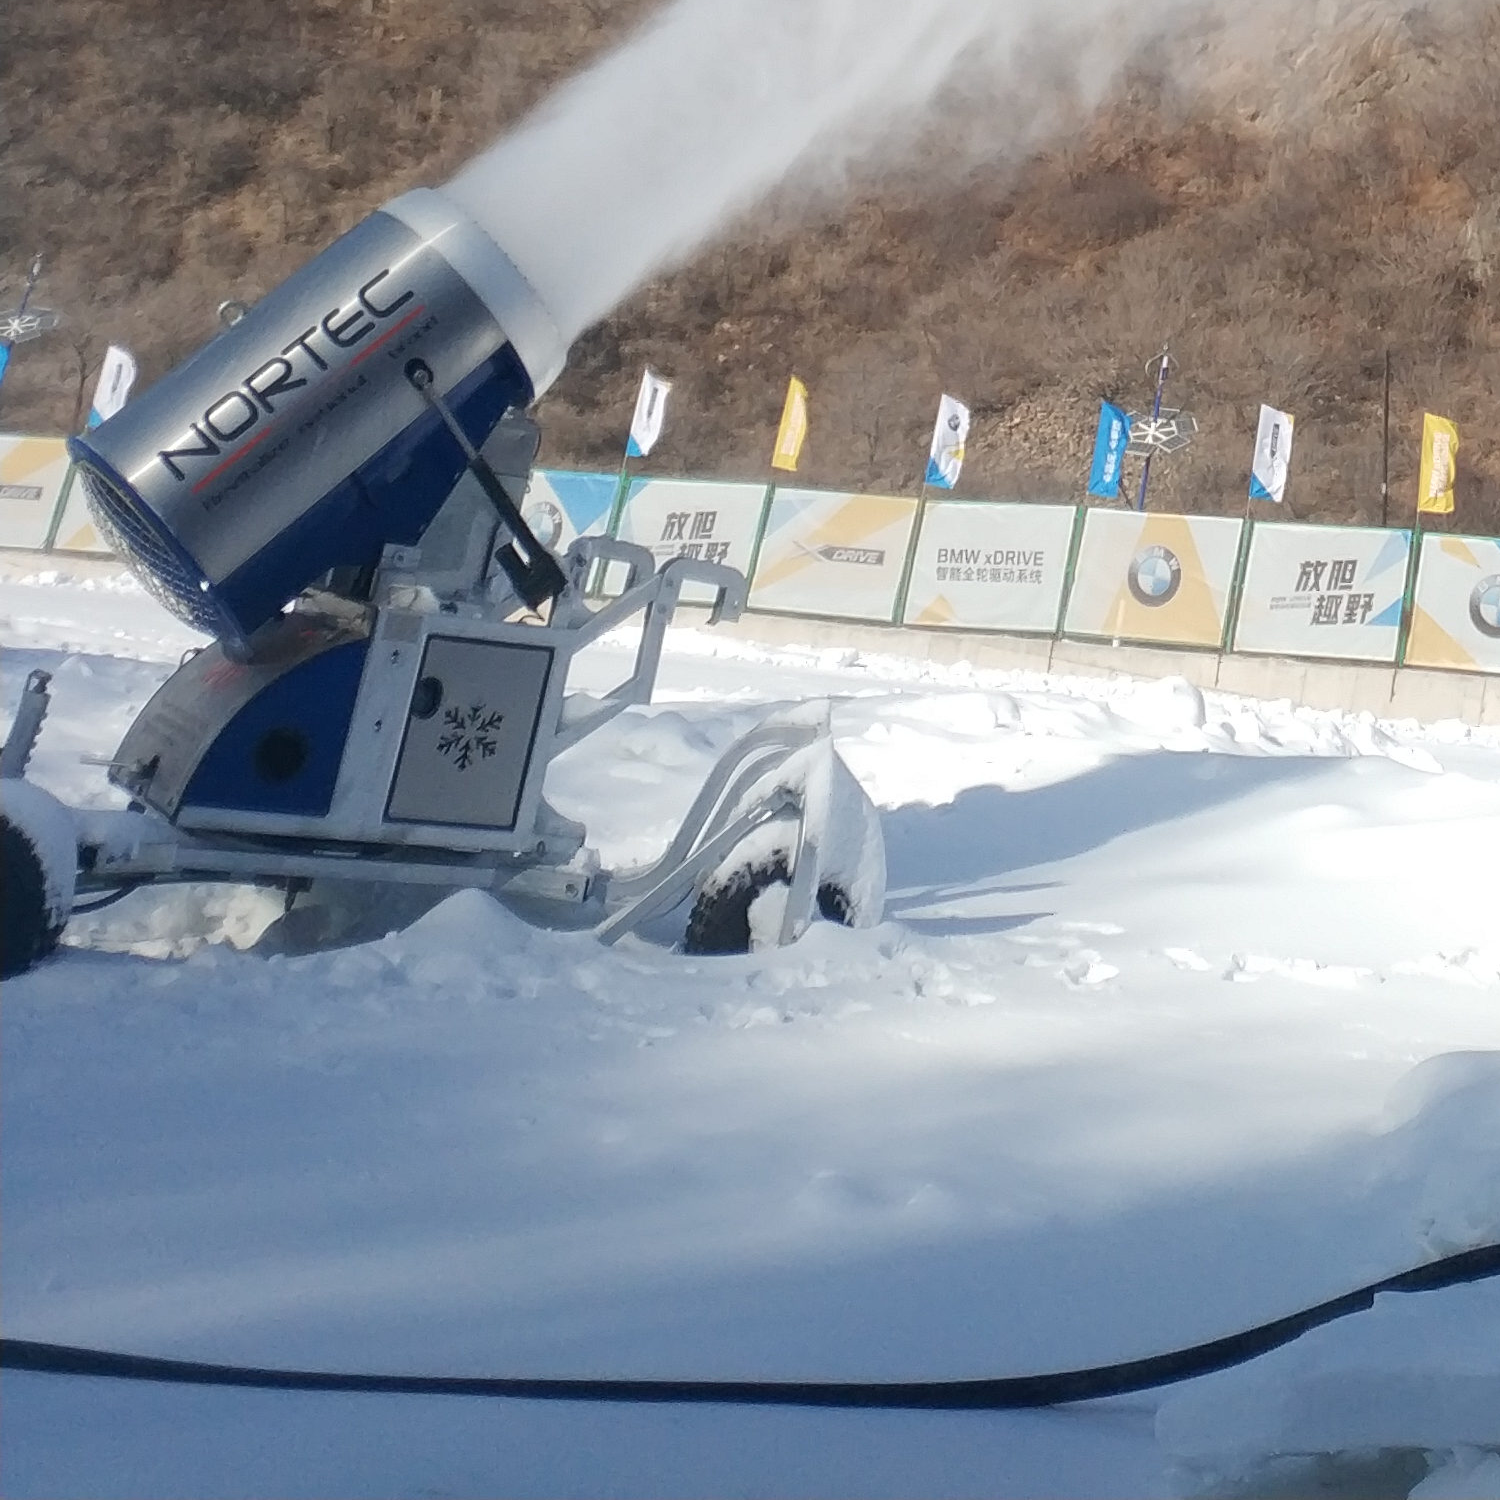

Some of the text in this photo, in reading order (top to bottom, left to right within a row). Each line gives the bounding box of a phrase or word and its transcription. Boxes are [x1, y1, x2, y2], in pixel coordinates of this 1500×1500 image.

[158, 268, 415, 481] NORTEC
[660, 511, 718, 541] 放胆
[937, 548, 1044, 567] BMW xDRIVE
[936, 566, 1043, 584] 智能全轮驱动系统
[1295, 560, 1358, 592] 放胆
